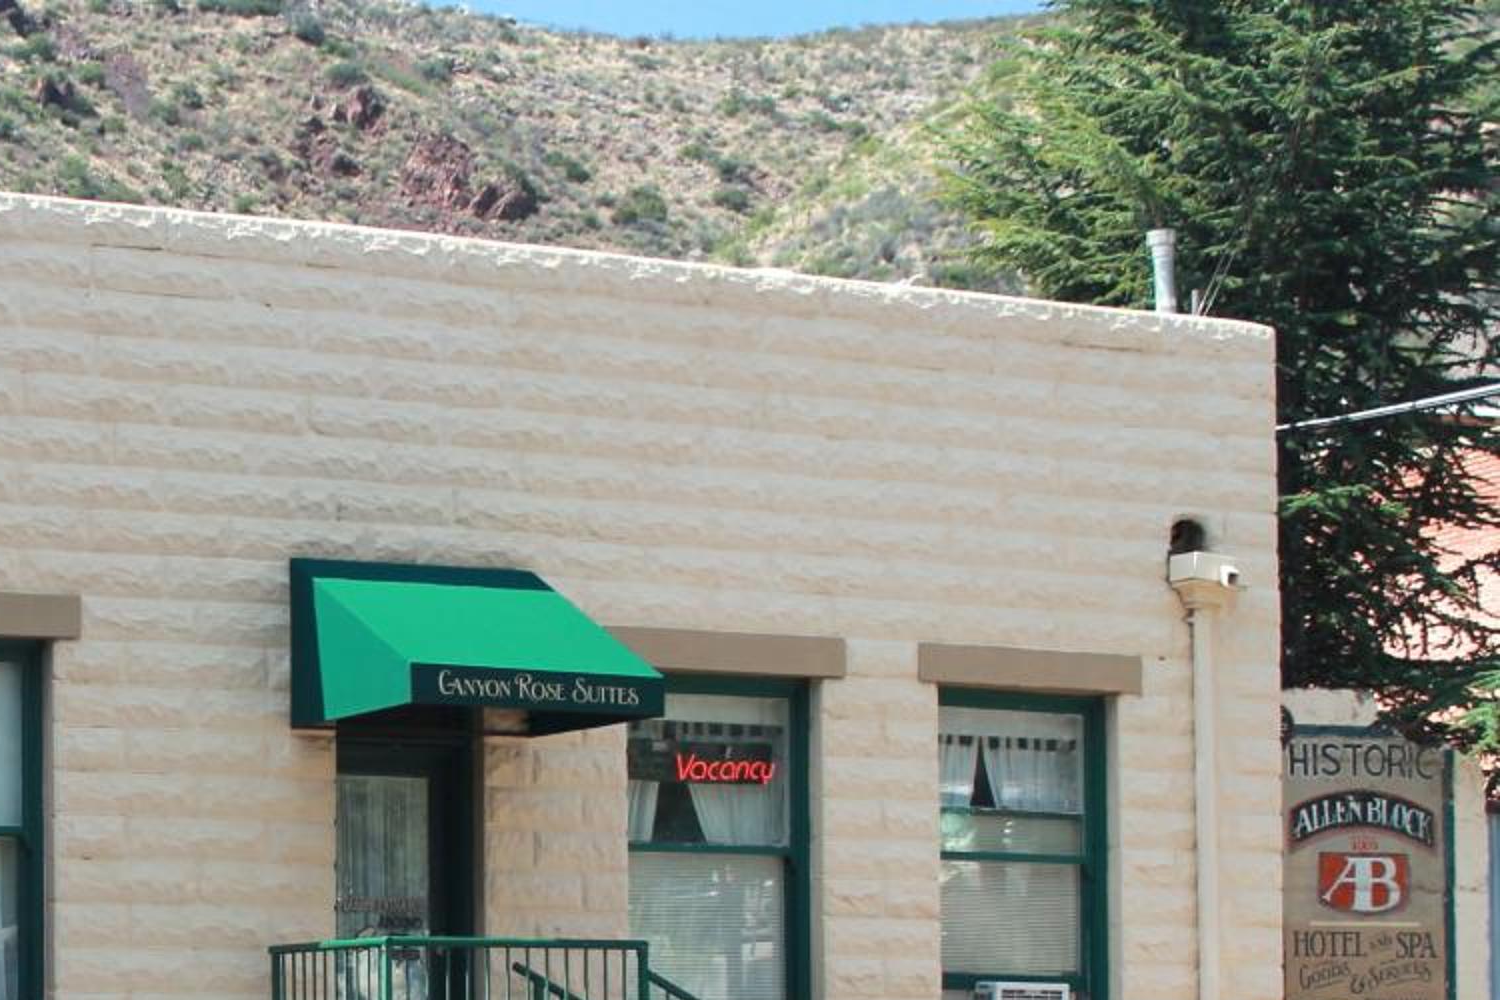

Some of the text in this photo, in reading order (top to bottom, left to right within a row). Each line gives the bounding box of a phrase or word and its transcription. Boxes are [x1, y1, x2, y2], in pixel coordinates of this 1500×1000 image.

[677, 753, 776, 785] Vacancy
[1289, 743, 1433, 780] HISTORIC
[1294, 796, 1432, 845] ALLEN BLOCK
[1321, 856, 1400, 912] AB
[1293, 930, 1367, 957] HOTEL
[1395, 931, 1437, 959] SPA
